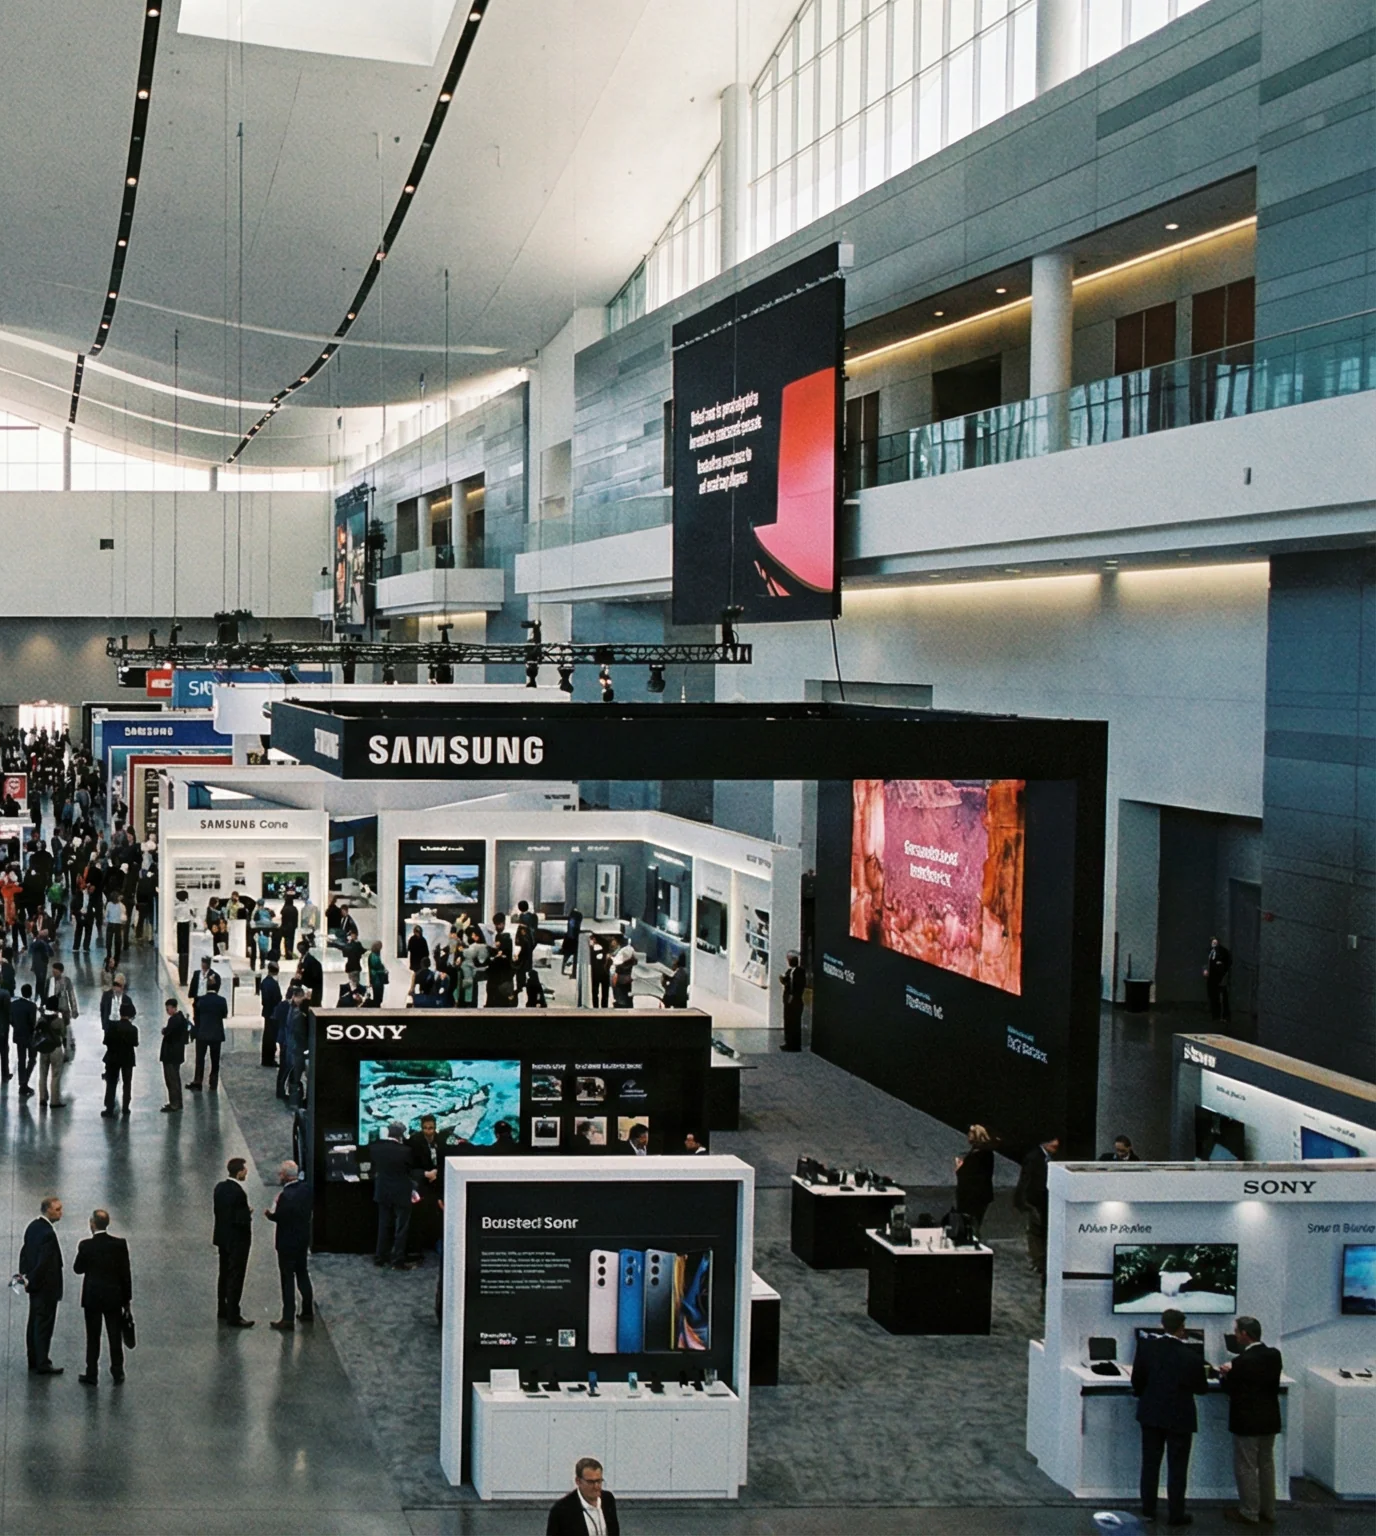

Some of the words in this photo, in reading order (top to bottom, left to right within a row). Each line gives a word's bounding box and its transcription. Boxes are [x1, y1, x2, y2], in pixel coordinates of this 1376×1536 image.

[368, 735, 544, 765] SAMSUNG
[326, 1024, 407, 1040] SONY
[1243, 1180, 1317, 1195] SONY
